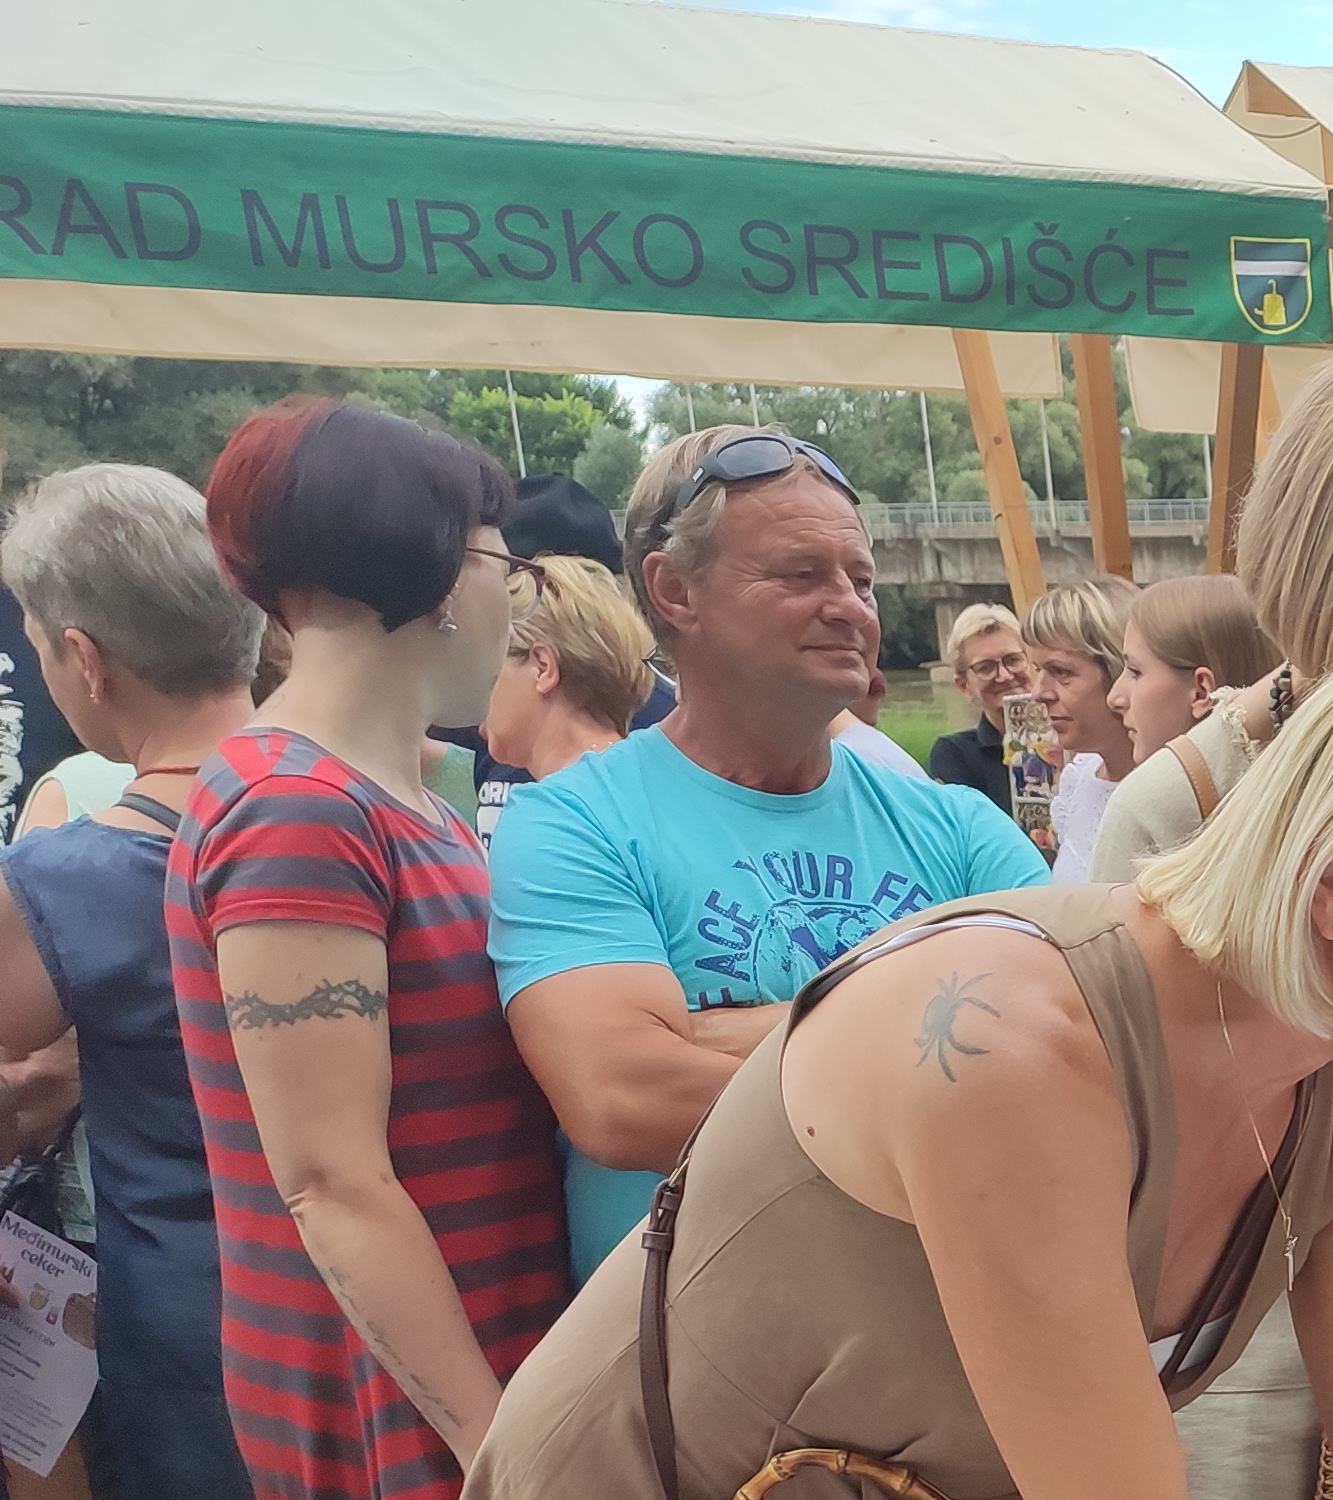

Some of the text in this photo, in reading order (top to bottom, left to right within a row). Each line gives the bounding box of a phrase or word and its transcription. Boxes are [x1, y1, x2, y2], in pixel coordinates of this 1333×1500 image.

[239, 188, 704, 288] MURSKO
[738, 219, 1196, 317] SREDIŠĆE
[730, 848, 854, 901] YOUR
[20, 1248, 65, 1278] ceker
